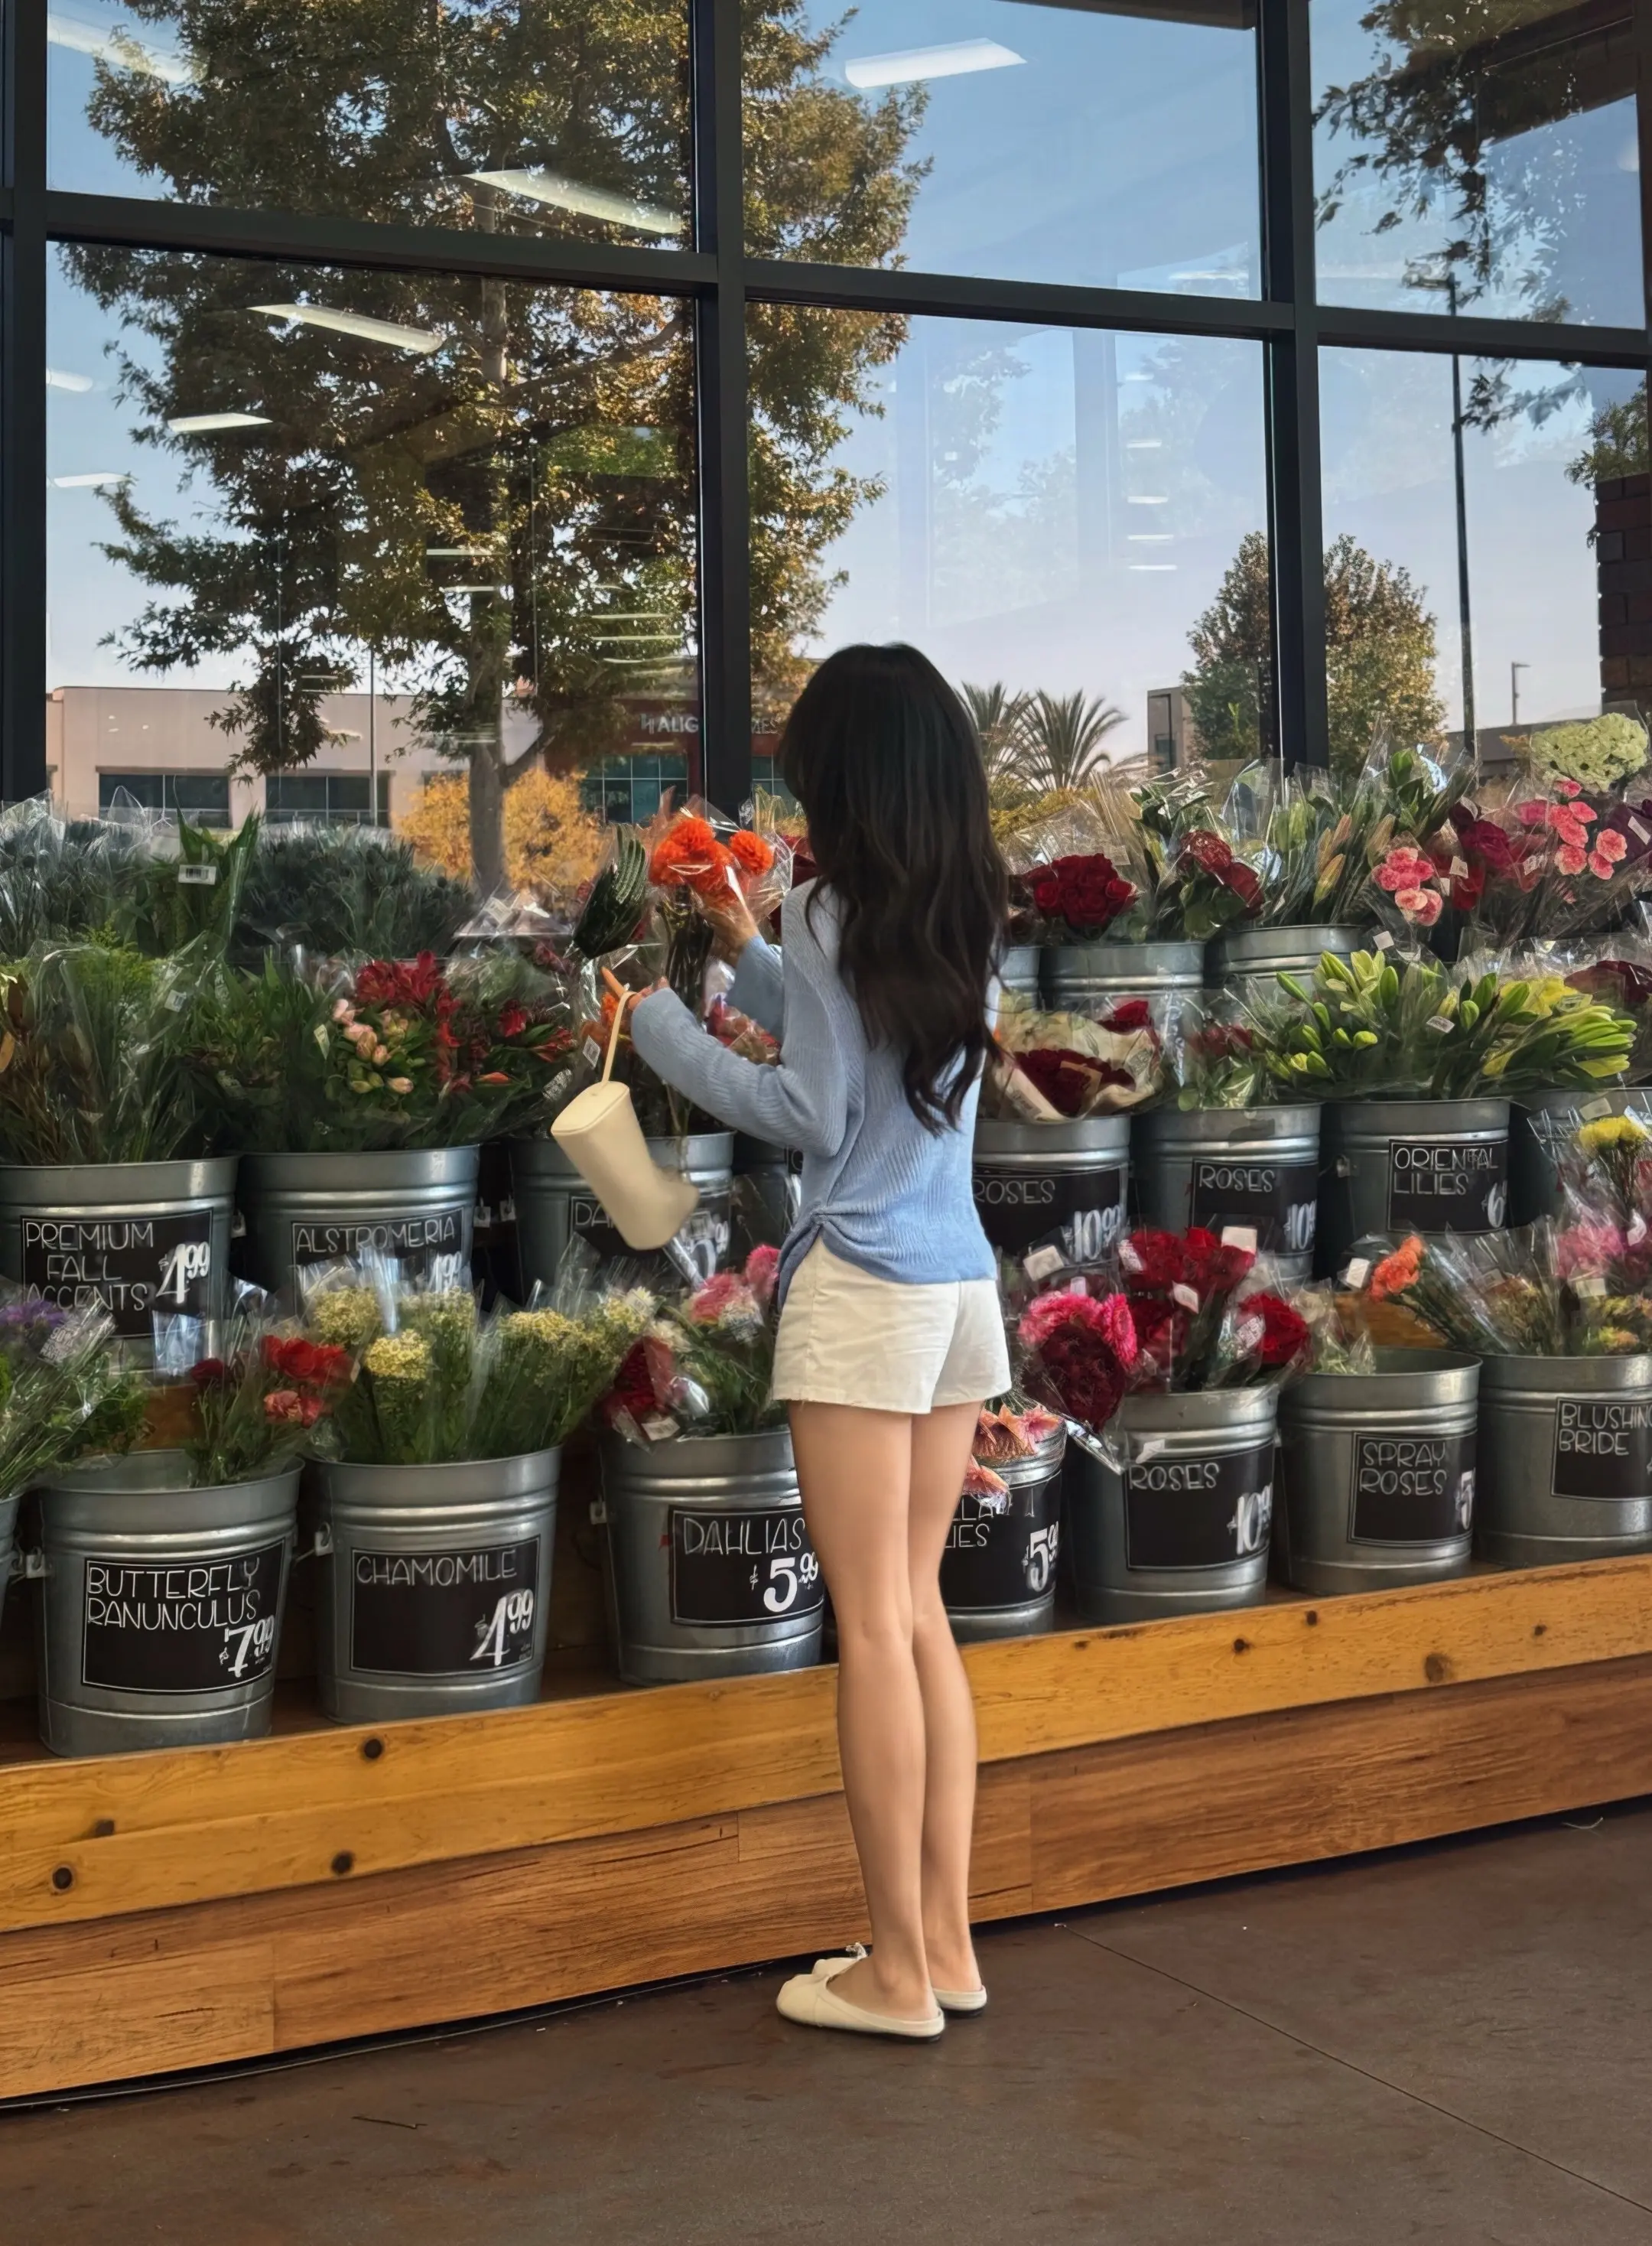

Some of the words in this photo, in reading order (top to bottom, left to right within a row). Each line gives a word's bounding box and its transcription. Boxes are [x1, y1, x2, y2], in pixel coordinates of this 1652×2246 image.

[972, 1179, 1055, 1204] ROSES
[1199, 1164, 1275, 1193] ROSES
[1393, 1171, 1469, 1195] LILIES
[26, 1222, 154, 1251] PREMIUM
[296, 1216, 455, 1253] ALSTROMERIA
[47, 1255, 122, 1281] FALL
[1363, 1442, 1446, 1467] SPRAY
[1559, 1429, 1630, 1456] BRIDE
[1129, 1463, 1220, 1491] ROSES
[1359, 1468, 1447, 1496] ROSES
[684, 1517, 805, 1555] DAHLIAS
[88, 1557, 260, 1599] BUTTERFLY
[356, 1549, 517, 1586] CHAMOMILE
[88, 1589, 260, 1630] RANUNCULUS
